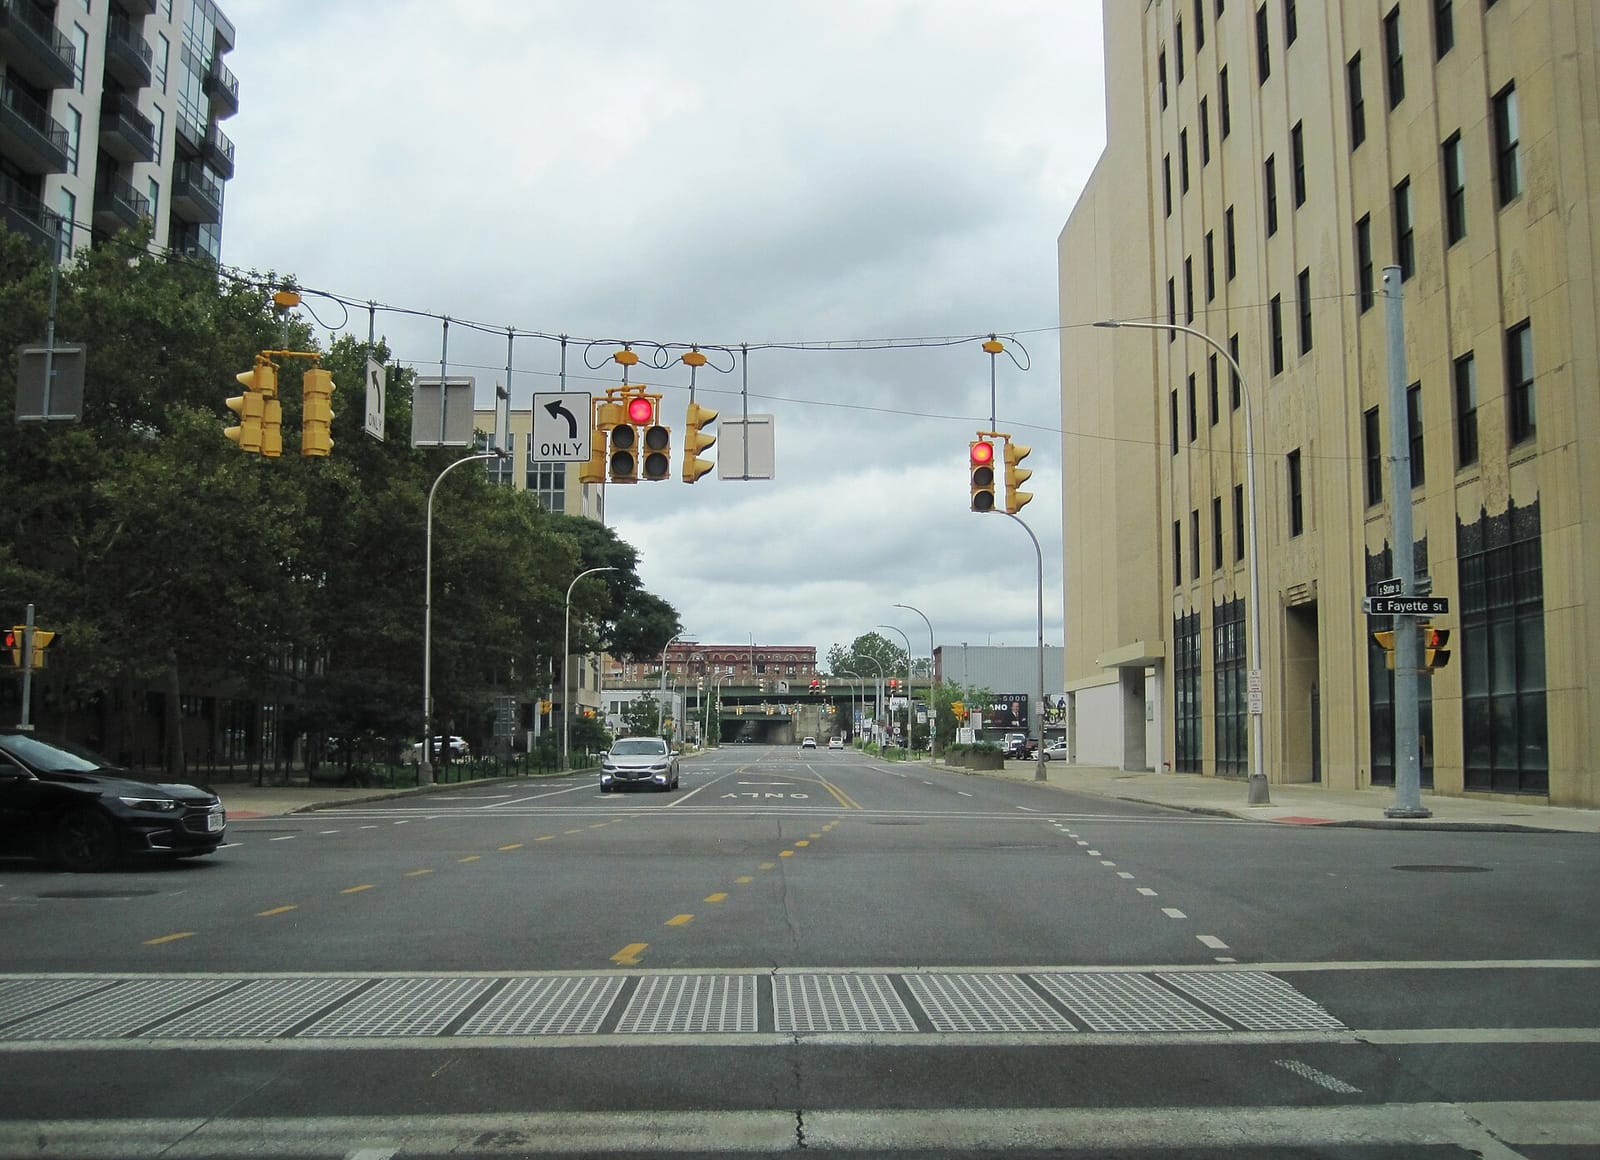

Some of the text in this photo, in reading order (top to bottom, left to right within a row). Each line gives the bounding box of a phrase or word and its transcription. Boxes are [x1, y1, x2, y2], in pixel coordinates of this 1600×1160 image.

[368, 413, 382, 431] ONLY
[541, 443, 582, 456] ONLY
[1377, 601, 1442, 613] E Fayette St
